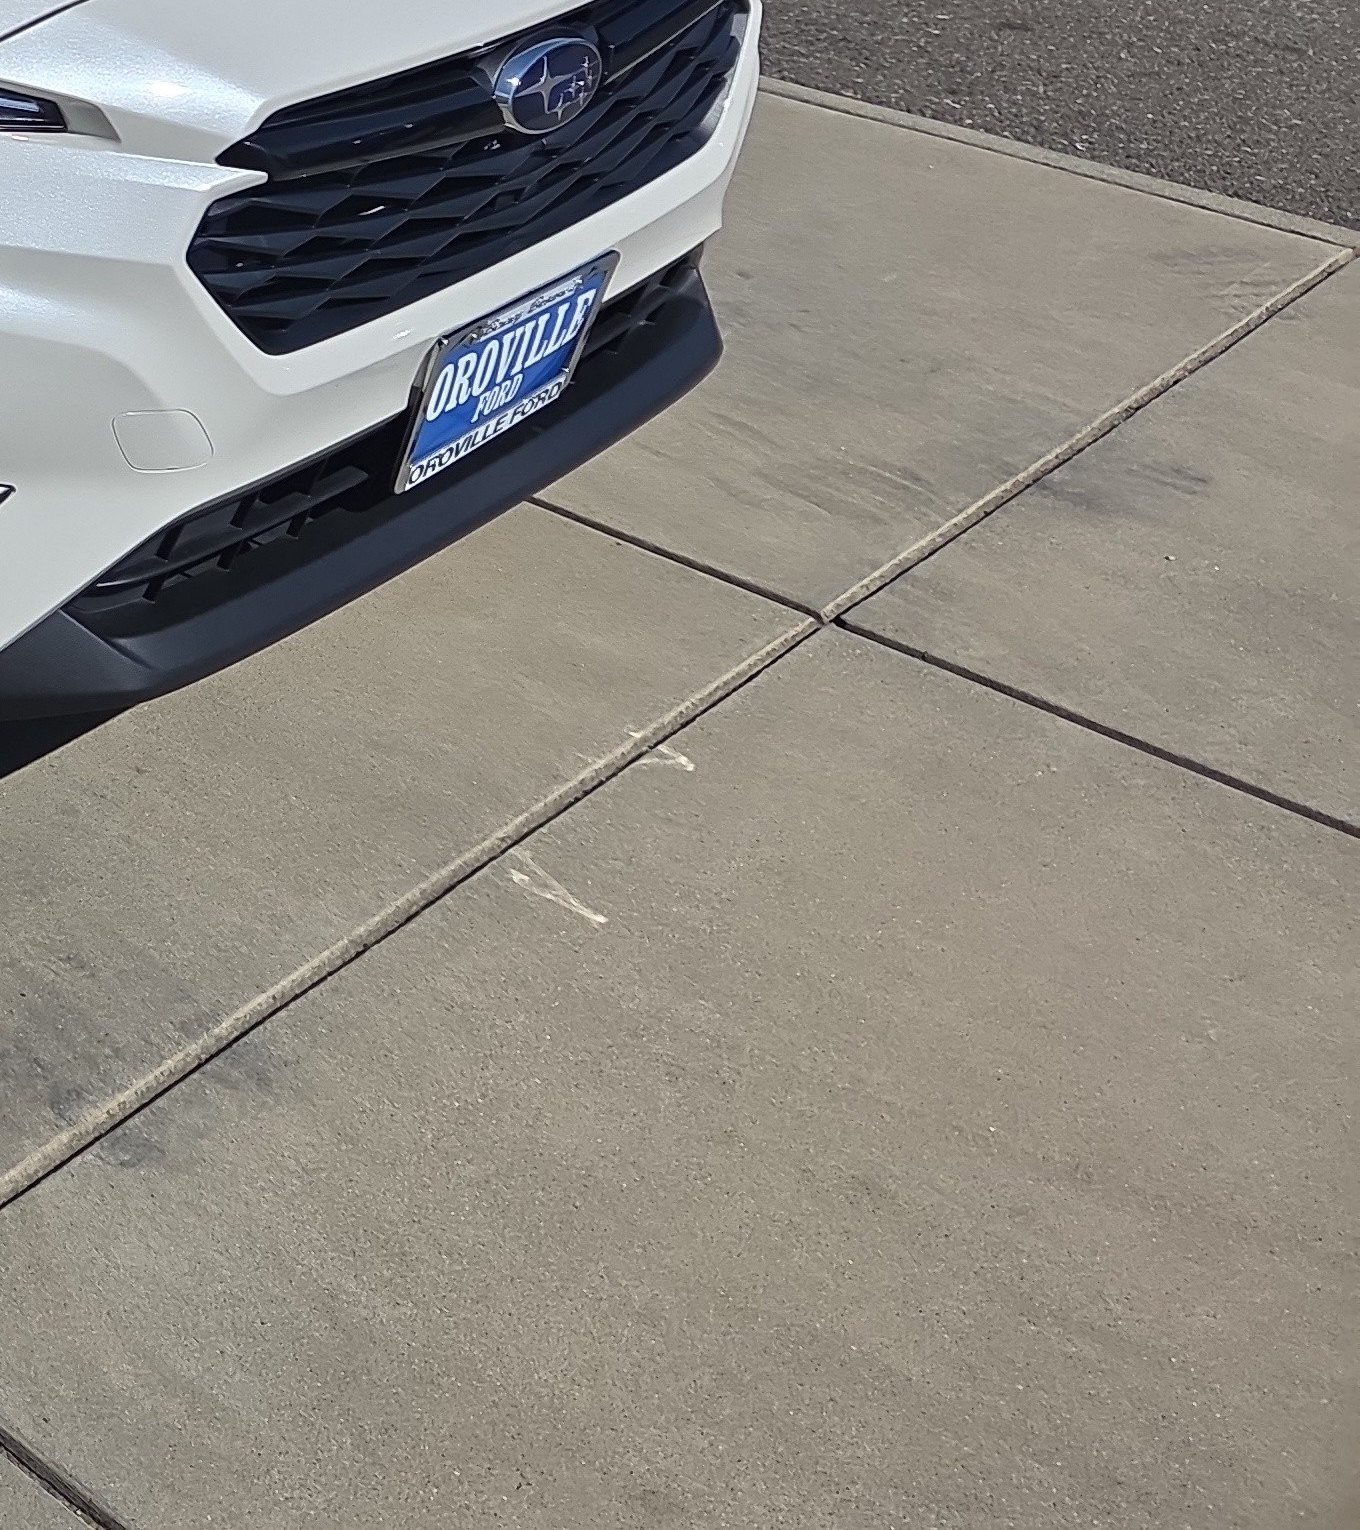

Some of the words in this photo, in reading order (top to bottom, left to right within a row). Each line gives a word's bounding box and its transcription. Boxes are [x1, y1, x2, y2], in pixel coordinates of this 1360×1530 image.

[426, 288, 597, 421] OROVILLE
[471, 373, 523, 424] FORD
[409, 411, 509, 485] OROVILLE
[512, 381, 565, 423] FORD
